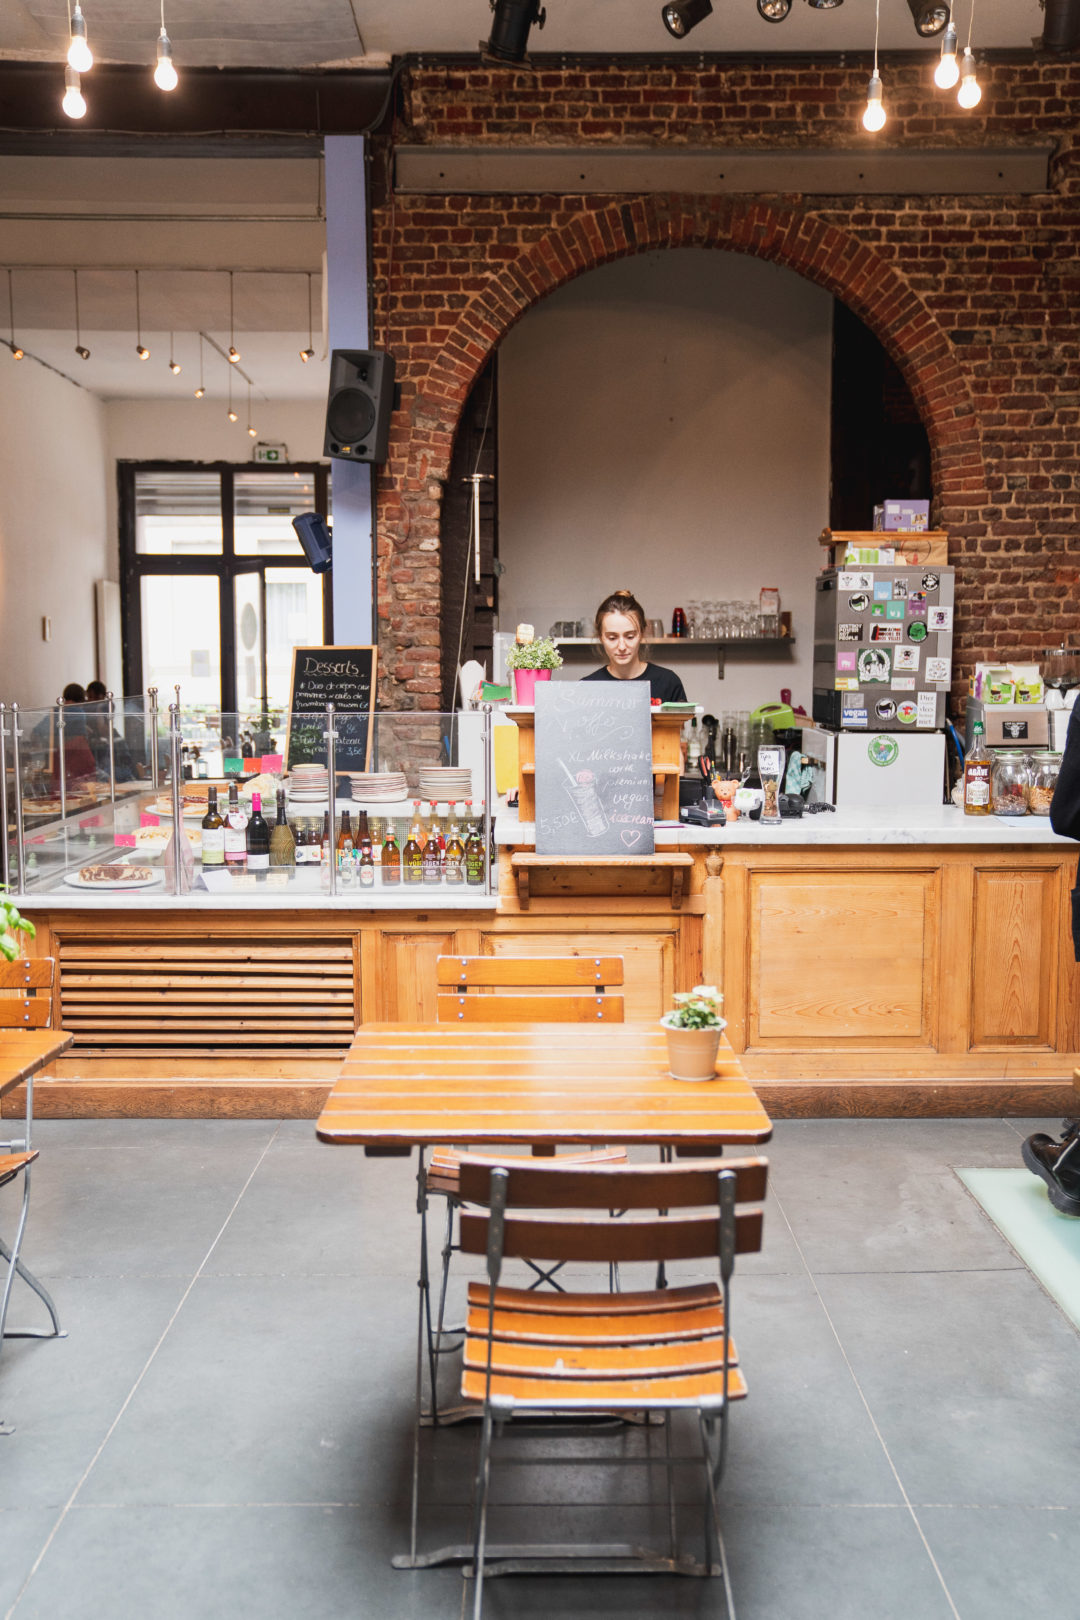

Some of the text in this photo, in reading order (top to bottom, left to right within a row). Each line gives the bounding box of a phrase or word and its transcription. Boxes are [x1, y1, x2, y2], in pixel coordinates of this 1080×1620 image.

[843, 710, 867, 719] vegan
[568, 751, 584, 762] XL
[613, 793, 649, 809] vegan
